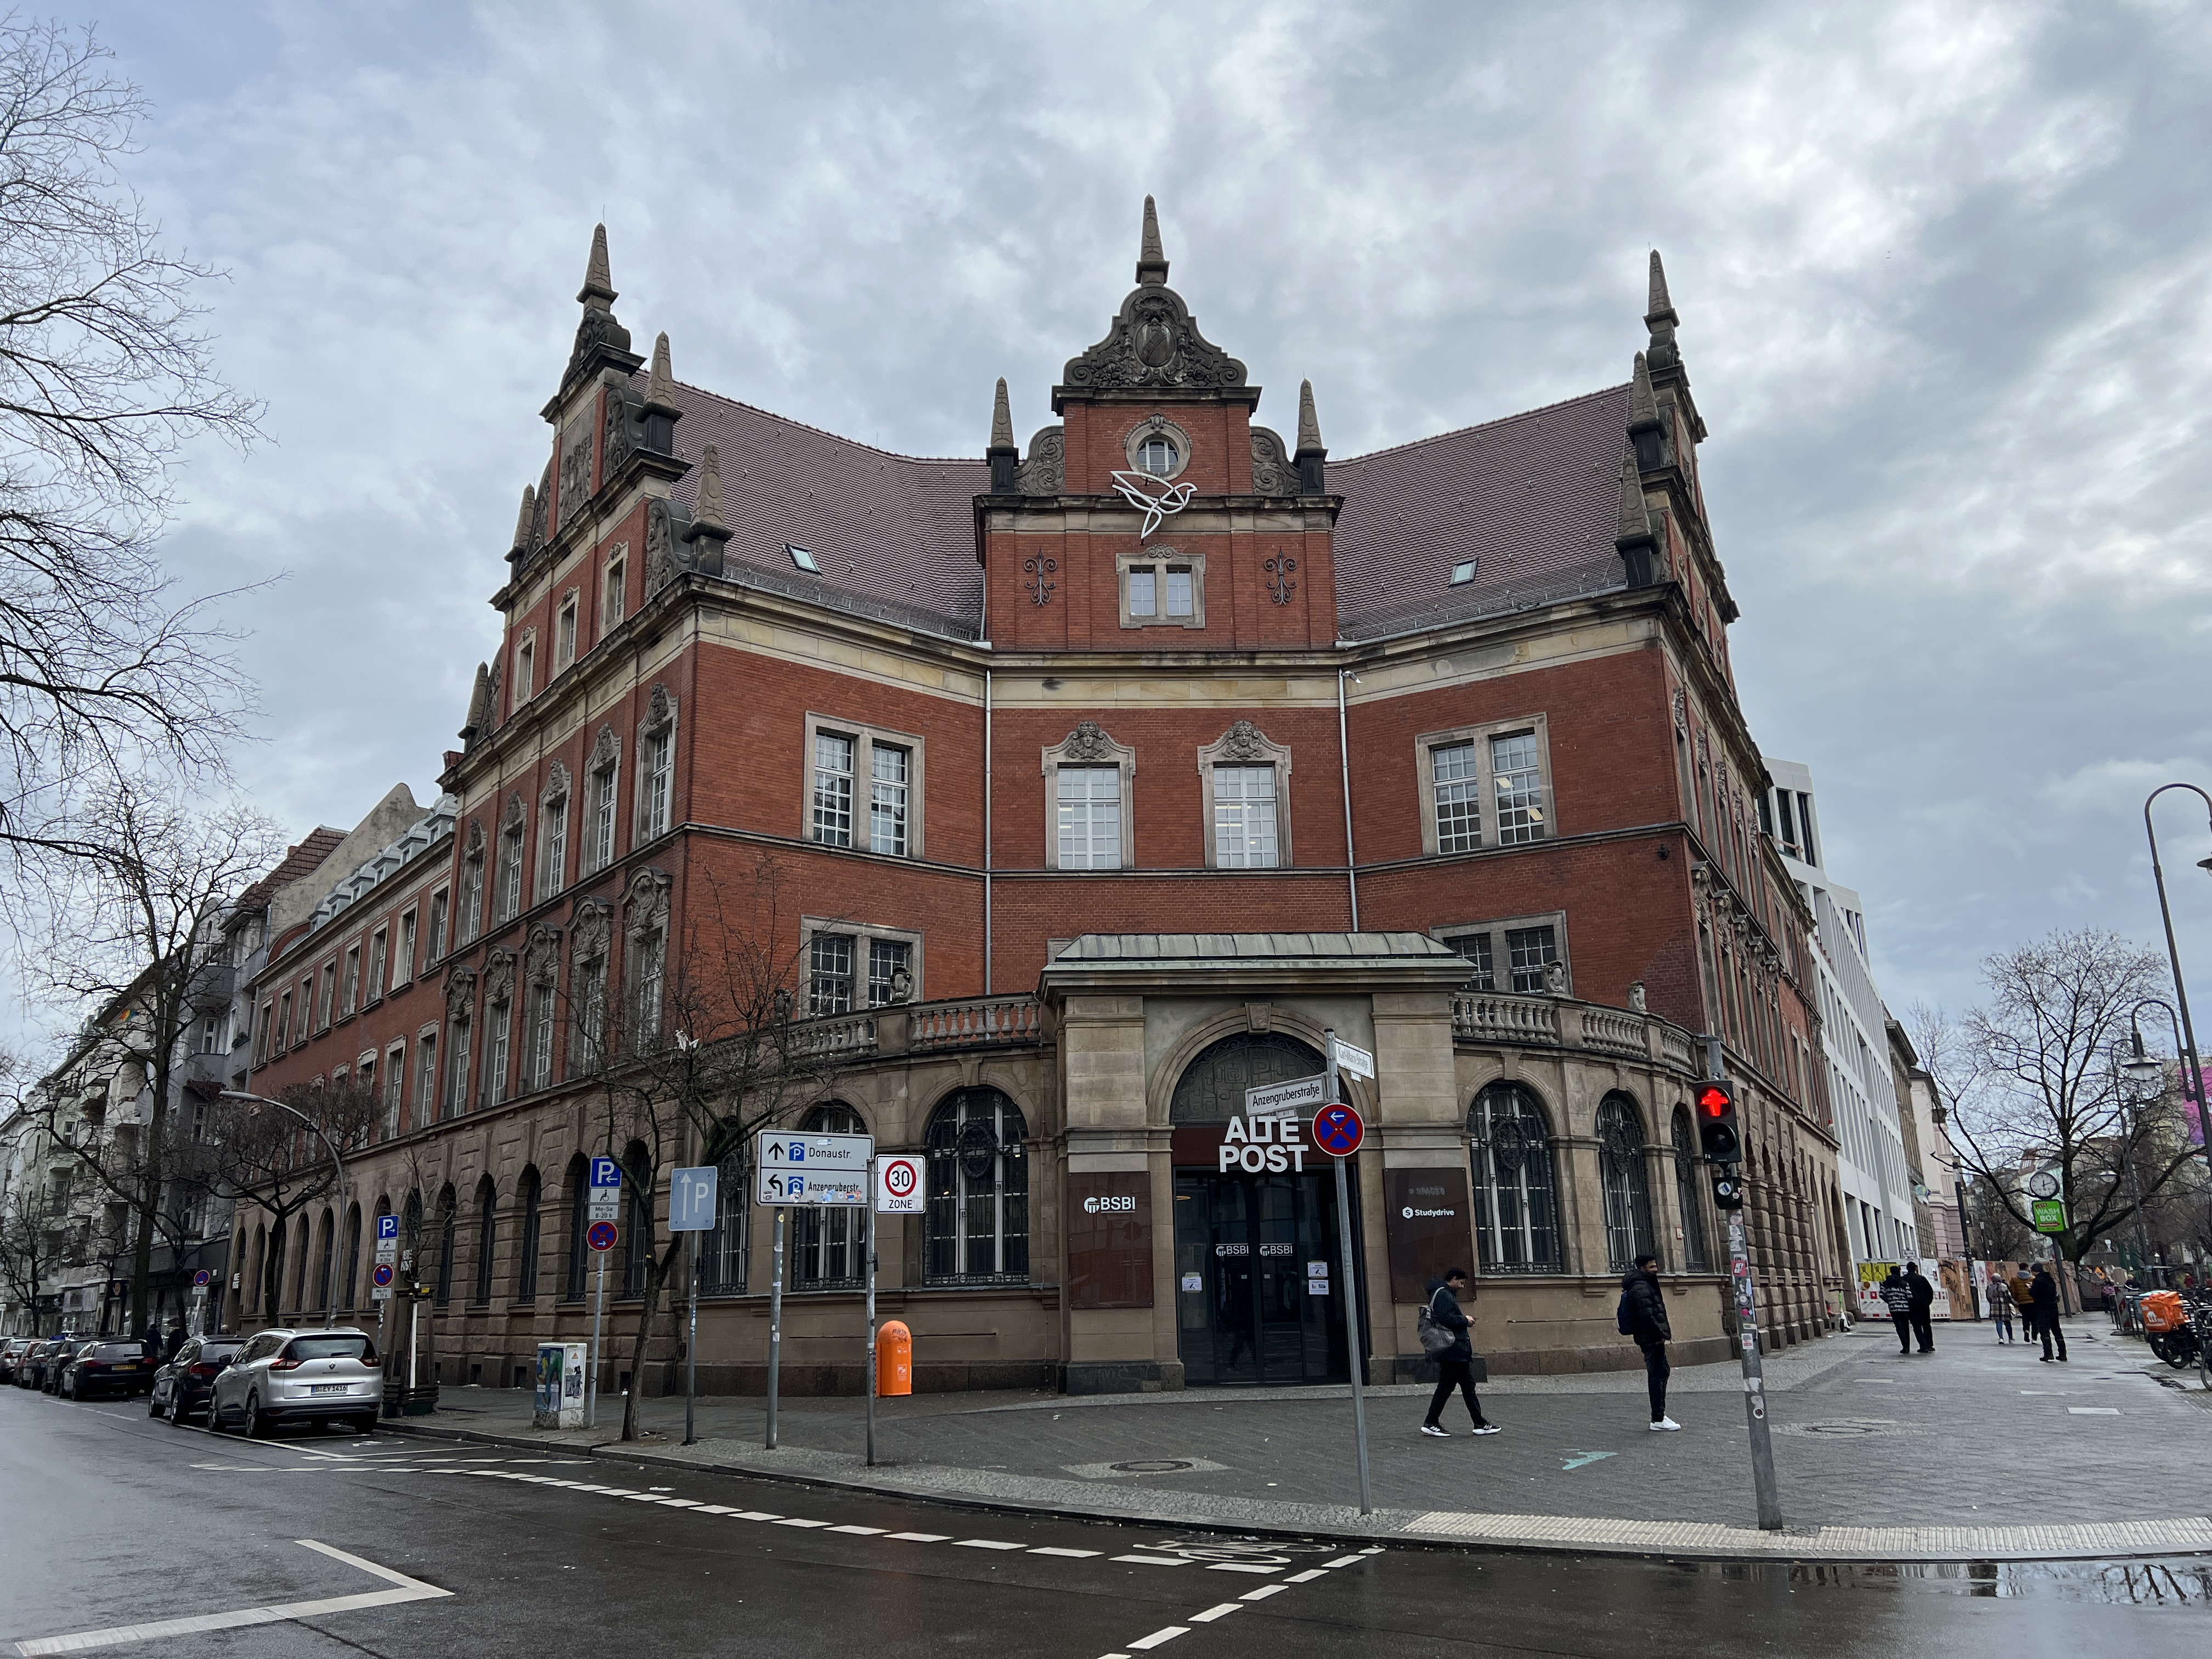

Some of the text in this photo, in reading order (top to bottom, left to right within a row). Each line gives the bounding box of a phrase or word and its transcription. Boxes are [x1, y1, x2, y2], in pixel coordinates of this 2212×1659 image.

[1252, 1083, 1320, 1107] Anzengruberstraße
[1224, 1116, 1300, 1143] ALTE
[793, 1148, 801, 1160] P
[1219, 1144, 1309, 1173] POST
[597, 1161, 615, 1184] P
[891, 1170, 910, 1187] 30
[695, 1183, 709, 1214] P
[889, 1200, 913, 1209] ZONE
[1101, 1197, 1136, 1210] BSBI
[1415, 1209, 1454, 1217] Studydrive
[382, 1218, 394, 1237] P
[1226, 1245, 1249, 1255] BSBI
[1270, 1245, 1293, 1255] BSBI
